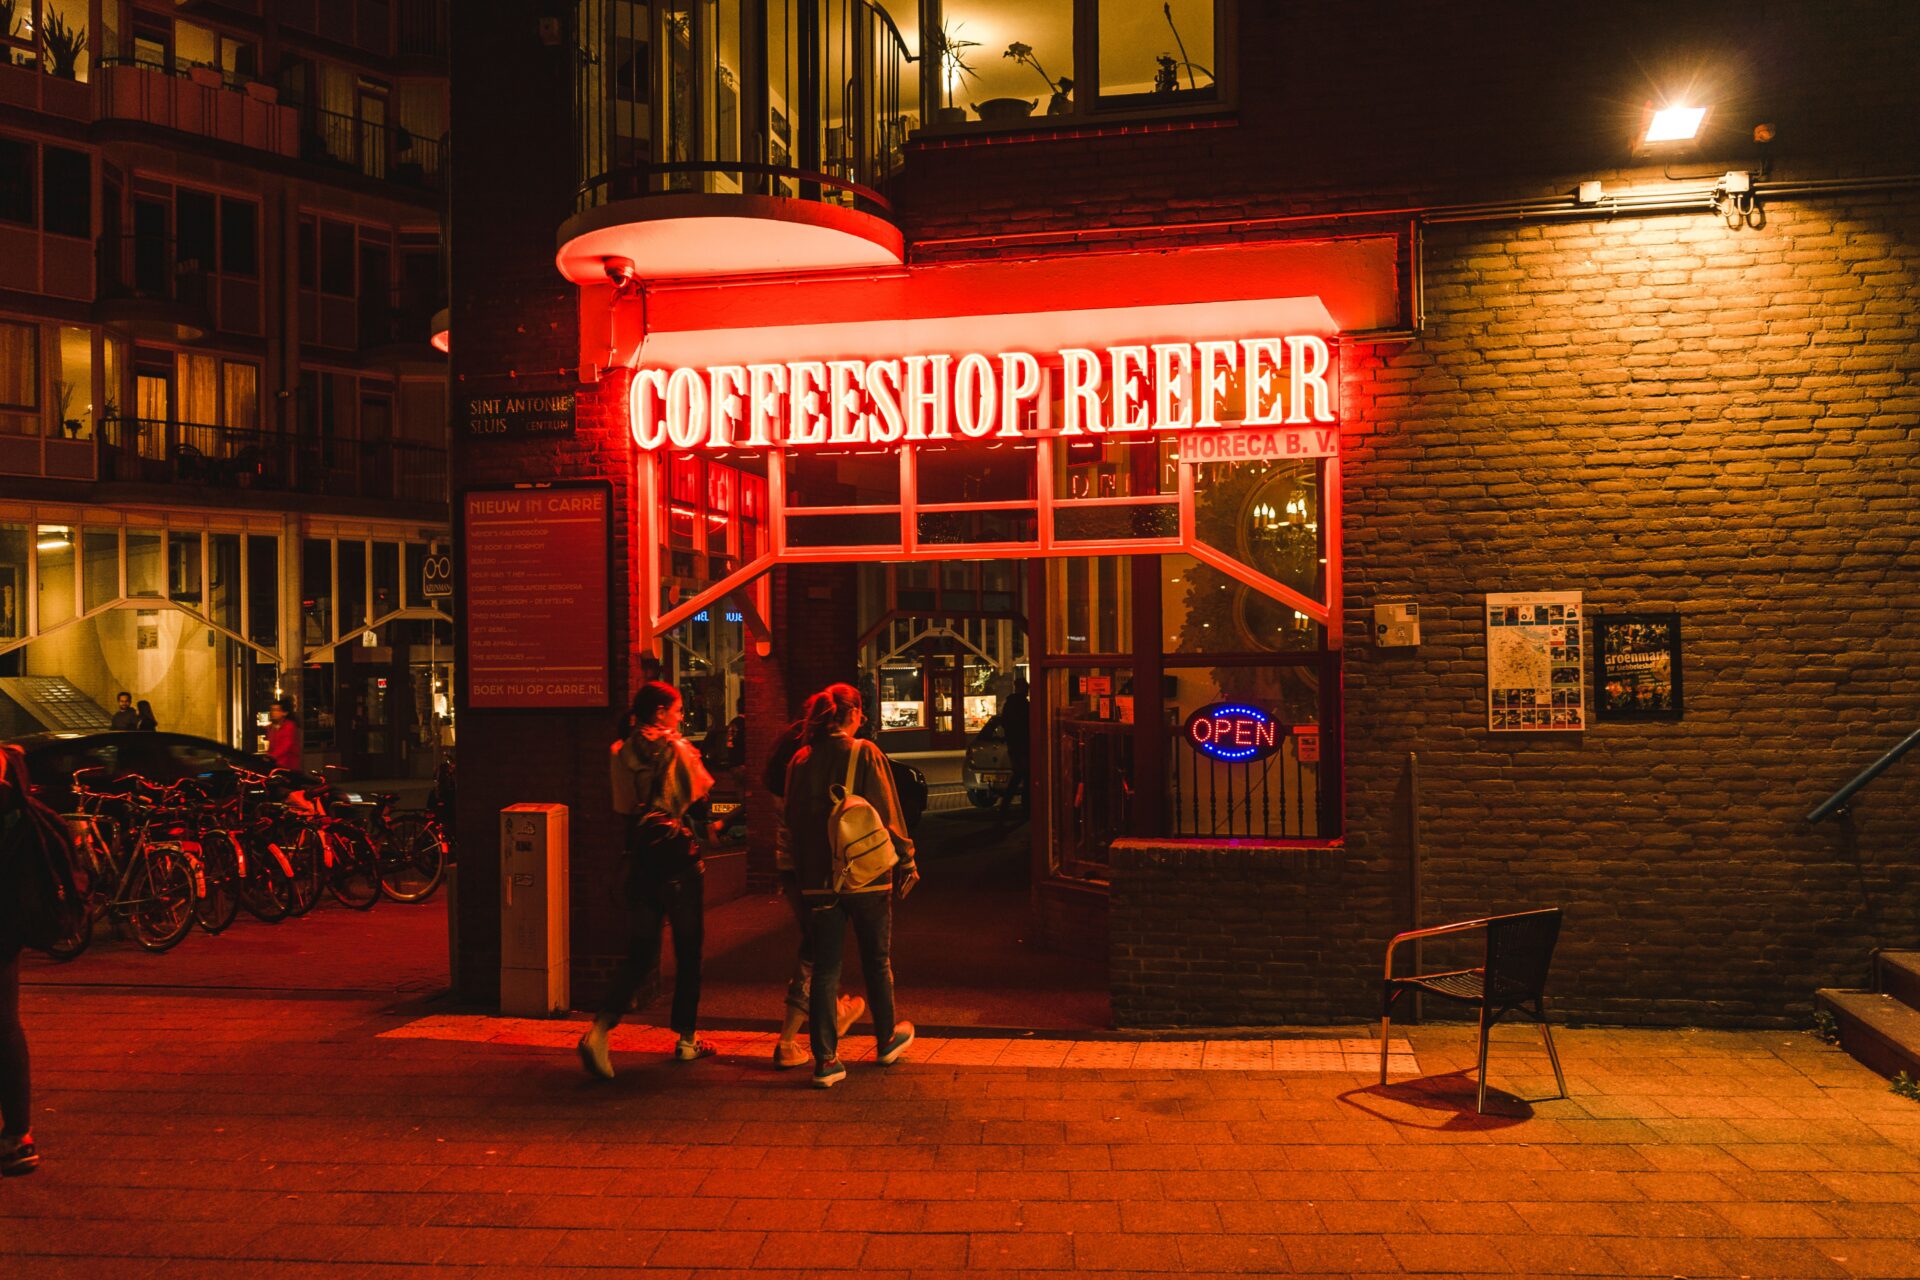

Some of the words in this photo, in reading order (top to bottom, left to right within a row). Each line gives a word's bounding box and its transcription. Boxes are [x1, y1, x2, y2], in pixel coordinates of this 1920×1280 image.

[630, 352, 1042, 450] COFFEESHOP
[1058, 334, 1338, 436] REEFER
[470, 400, 501, 415] SINT
[470, 418, 507, 433] SLUIS
[527, 421, 568, 431] CENTRUM
[1182, 435, 1279, 458] HORECA
[1286, 434, 1308, 453] B.
[1317, 431, 1336, 452] V.
[470, 500, 520, 514] NIEUW
[526, 500, 542, 512] IN
[473, 685, 504, 695] BOEK
[507, 685, 523, 694] NU
[527, 684, 544, 694] OP
[546, 684, 604, 694] CARRE.NL
[1192, 717, 1276, 747] OPEN
